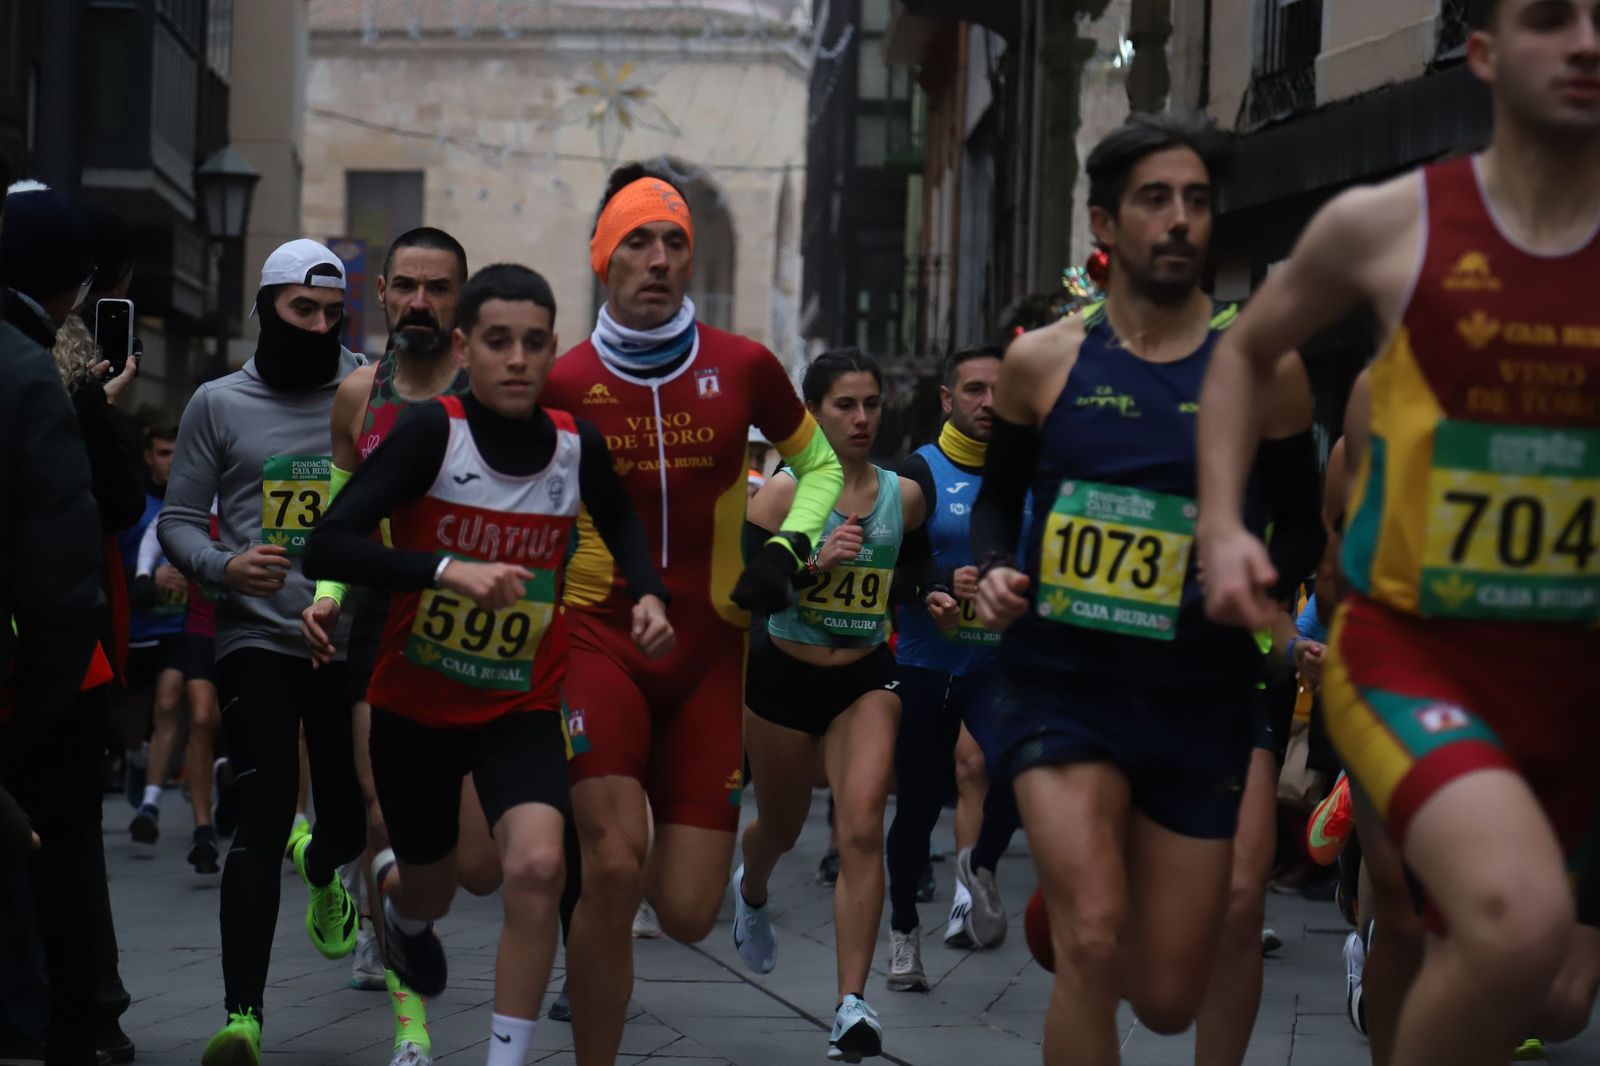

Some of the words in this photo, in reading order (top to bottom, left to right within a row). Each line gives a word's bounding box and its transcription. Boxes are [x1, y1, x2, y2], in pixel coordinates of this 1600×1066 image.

[625, 411, 692, 432] VINO
[605, 434, 638, 450] DE
[643, 426, 715, 448] TORO
[292, 460, 330, 468] FUNDAC
[675, 456, 715, 467] RURAL
[270, 490, 321, 527] 73
[291, 536, 306, 546] CA
[436, 513, 561, 562] CURTIUS
[1443, 490, 1597, 569] 704
[1056, 521, 1163, 589] 1073
[807, 571, 880, 608] 249
[1071, 600, 1109, 620] CAJA
[423, 595, 530, 658] 599
[823, 617, 847, 629] CAJA
[849, 619, 877, 630] RURA
[959, 631, 982, 641] CAJA
[983, 633, 1002, 642] RUR
[442, 656, 477, 679] CAJA
[480, 666, 524, 682] RURAL
